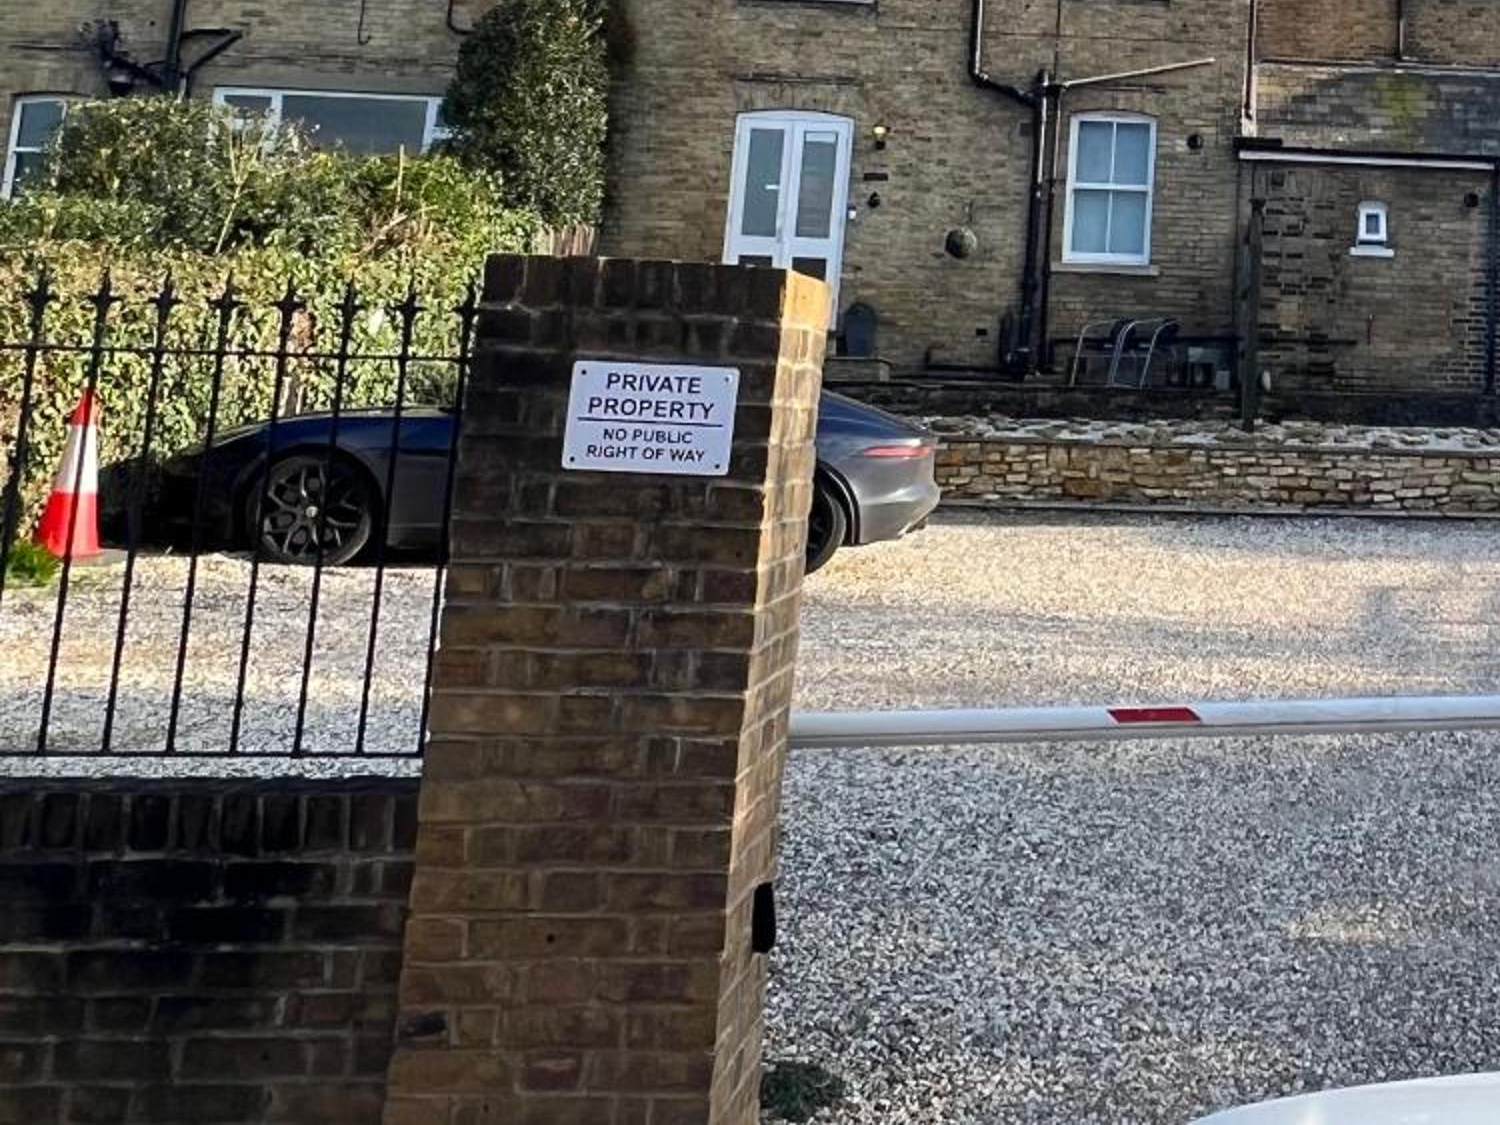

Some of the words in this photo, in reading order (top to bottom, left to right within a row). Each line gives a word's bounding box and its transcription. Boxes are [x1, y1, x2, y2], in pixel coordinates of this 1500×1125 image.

[606, 373, 702, 394] PRIVATE
[588, 397, 715, 420] PROPERTY
[603, 428, 627, 441] NO
[632, 429, 693, 444] PUBLIC
[586, 444, 638, 459] RIGHT
[641, 448, 665, 460] OF
[669, 449, 705, 462] WAY
